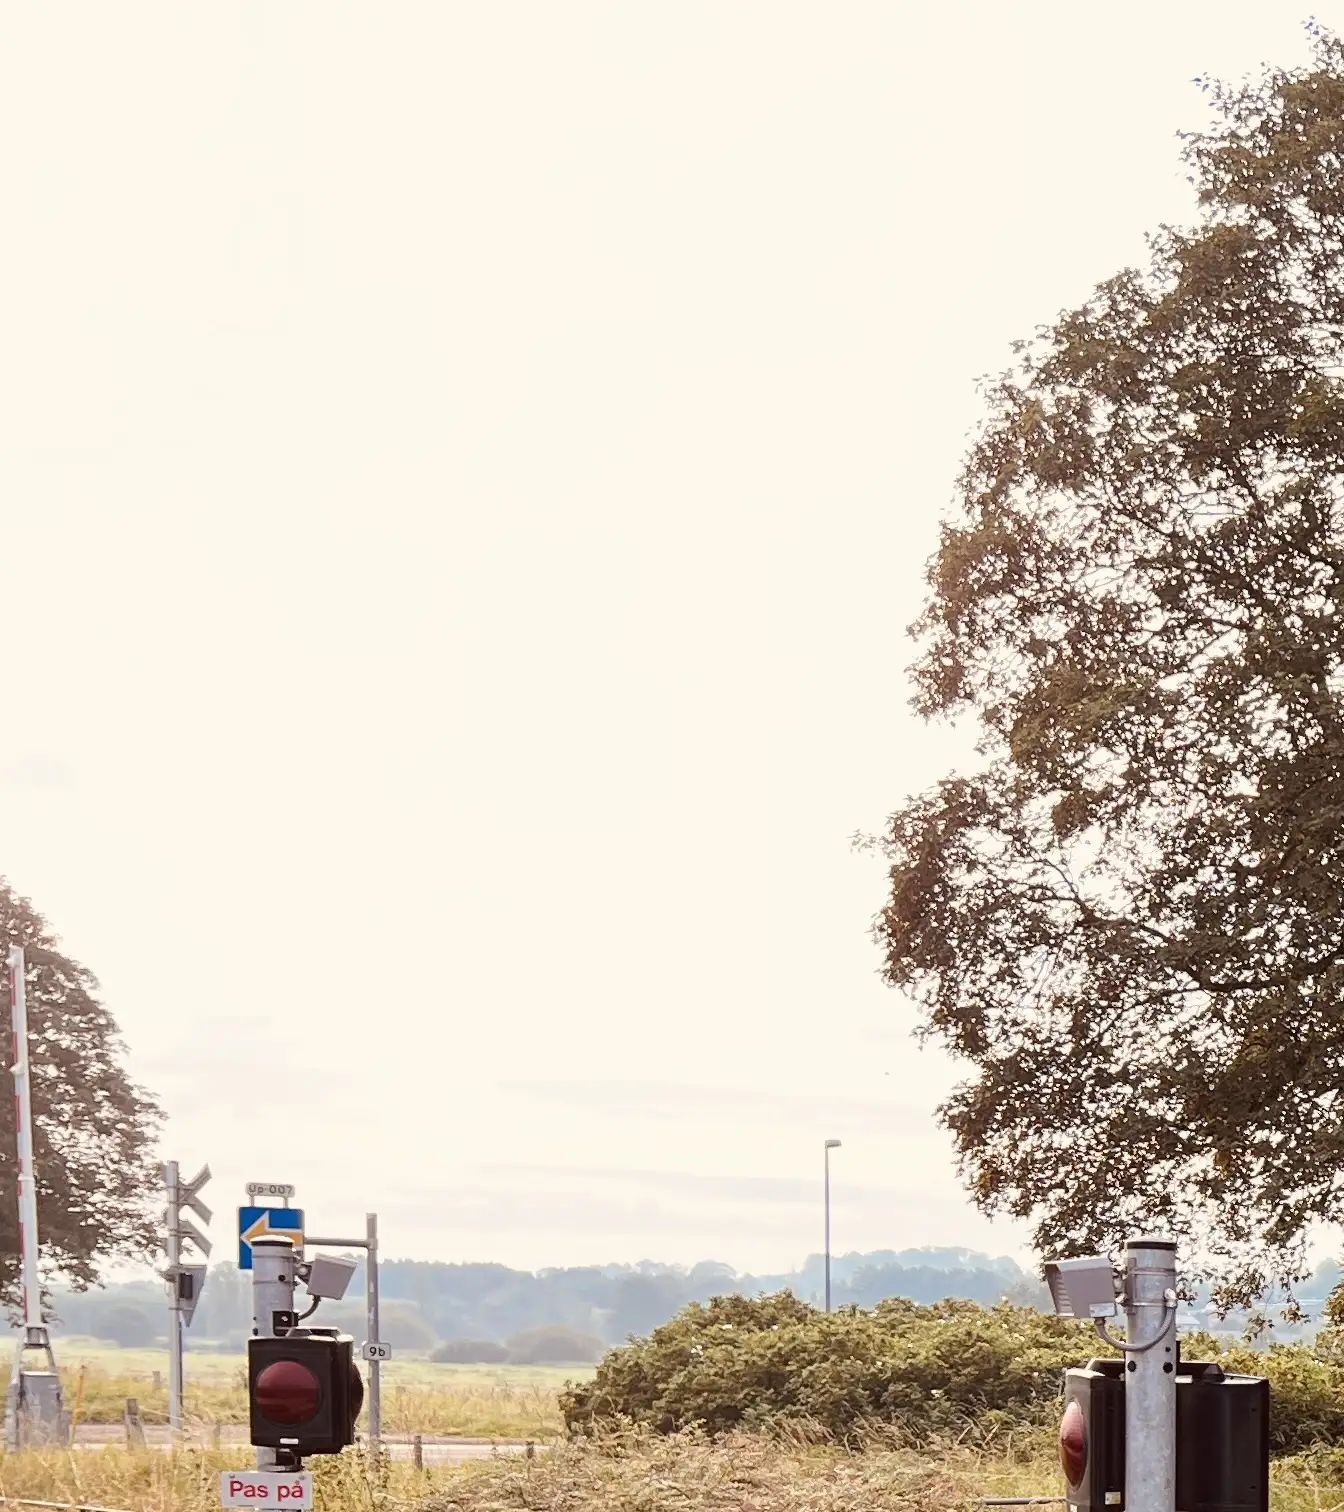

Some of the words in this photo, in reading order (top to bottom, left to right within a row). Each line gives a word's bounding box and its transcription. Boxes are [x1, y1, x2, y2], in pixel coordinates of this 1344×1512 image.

[369, 1346, 386, 1357] 9b
[229, 1480, 269, 1498] Pas
[277, 1480, 304, 1502] på
